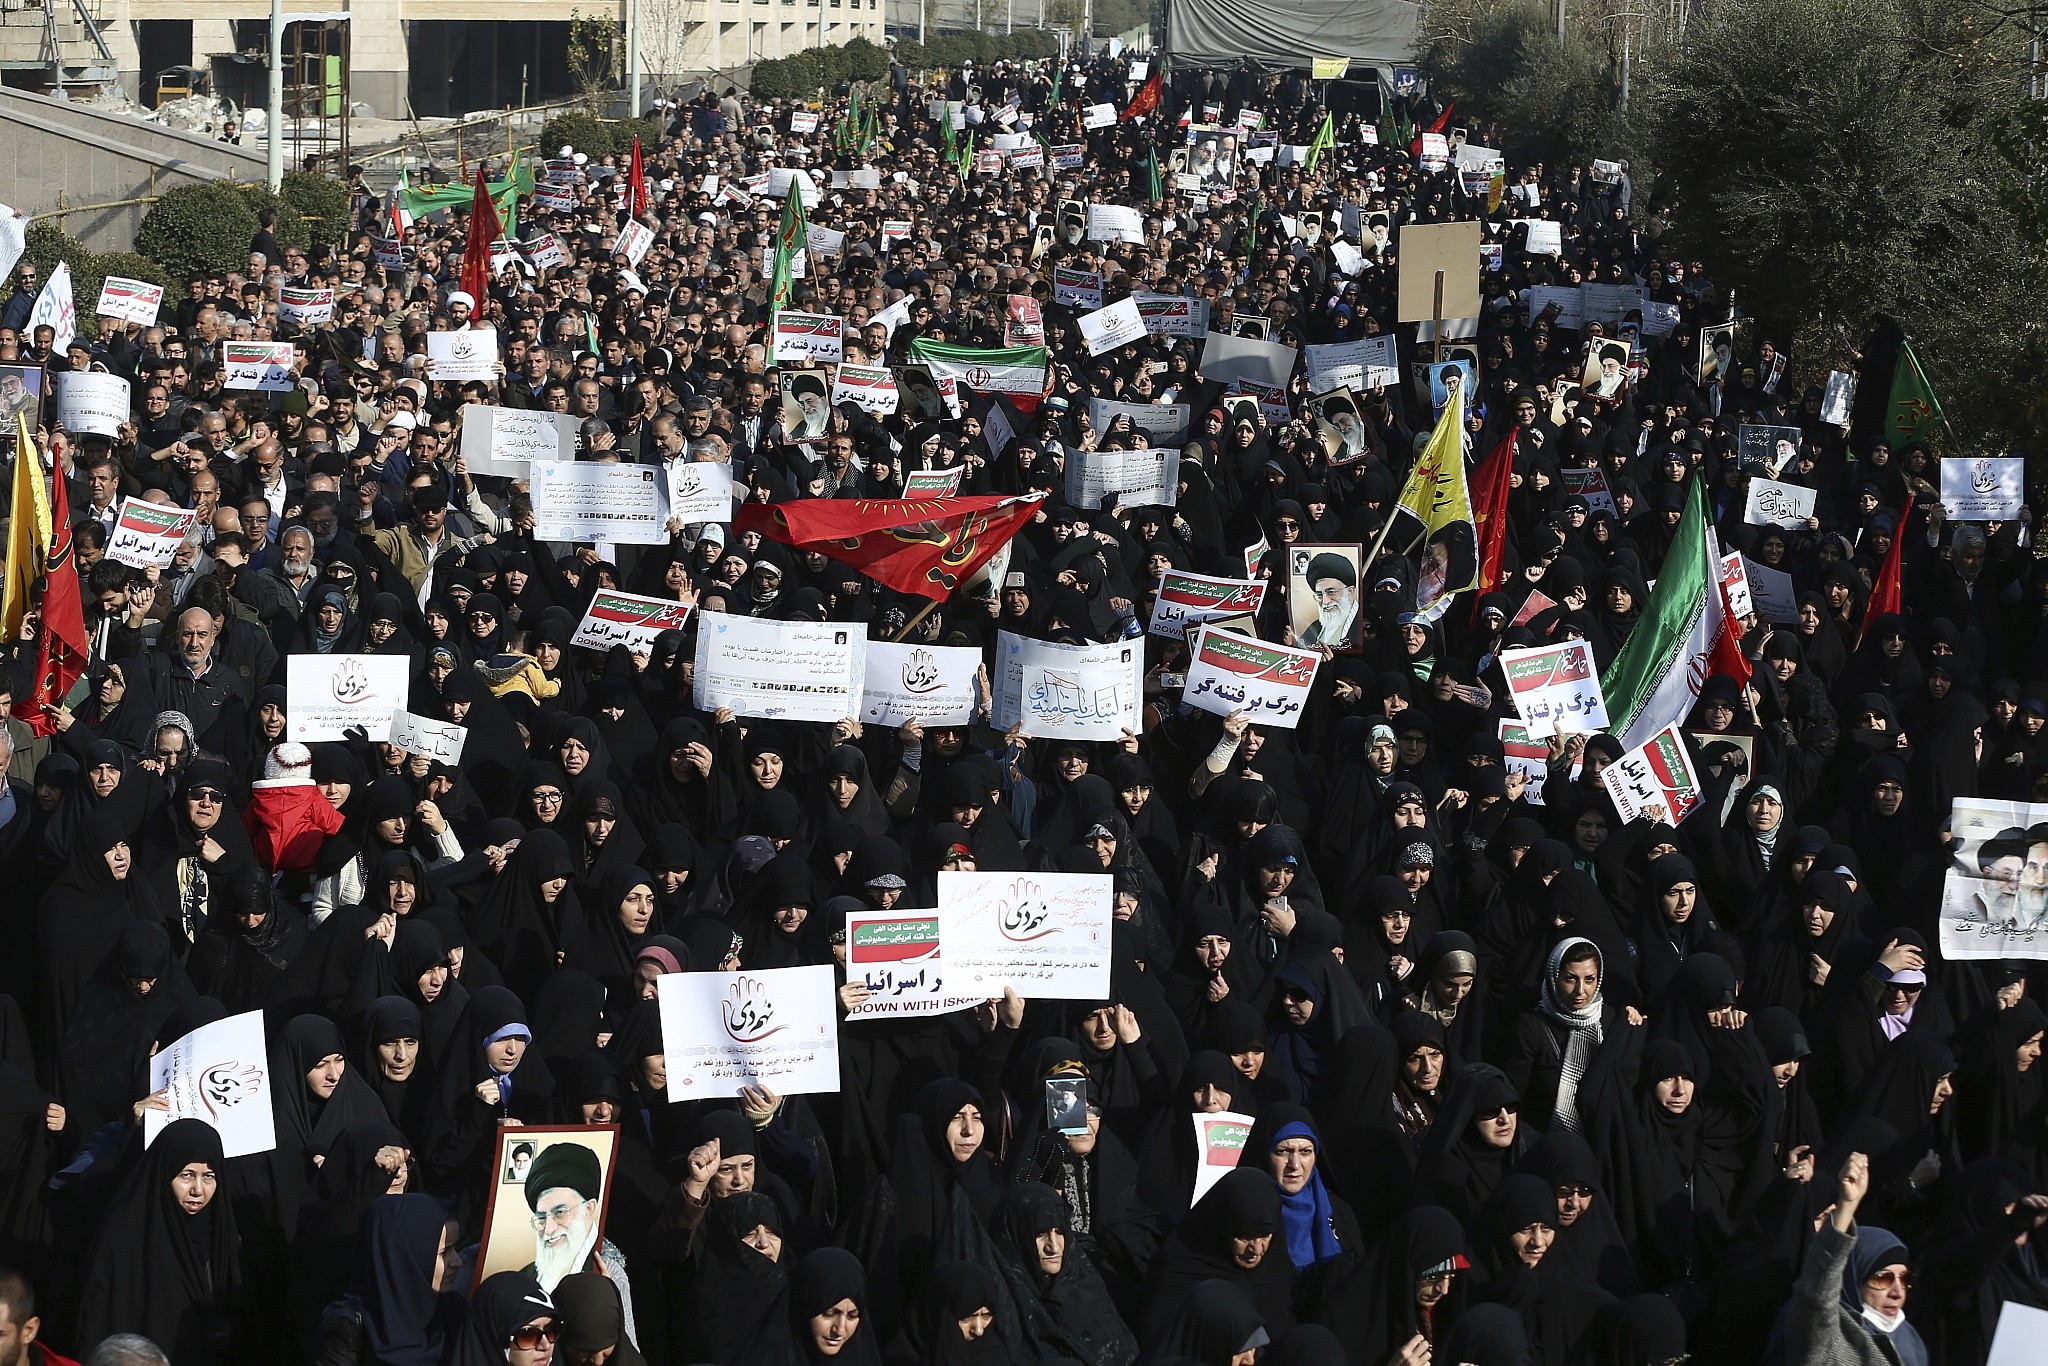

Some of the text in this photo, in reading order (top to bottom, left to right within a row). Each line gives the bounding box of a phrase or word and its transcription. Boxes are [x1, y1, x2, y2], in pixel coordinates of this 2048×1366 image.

[543, 251, 560, 261] مرگ
[102, 297, 129, 308] اسرائیل
[1085, 293, 1100, 304] مرگ
[139, 306, 155, 317] مرگ
[314, 309, 330, 318] مرگ
[1171, 318, 1189, 327] مرگ
[808, 344, 818, 354] بر
[819, 343, 840, 357] مرگ
[259, 374, 268, 384] بر
[865, 397, 876, 406] بر
[877, 396, 896, 408] مرگ
[1592, 496, 1612, 509] مرگ
[115, 534, 156, 553] اسرائیل
[109, 551, 136, 563] DOWN
[154, 547, 164, 557] بر
[582, 622, 643, 646] بر اسرائیل
[812, 634, 823, 642] علی
[576, 637, 607, 649] DOWN
[1230, 643, 1241, 651] قدرت
[907, 665, 925, 685] دی
[337, 674, 356, 695] دی
[1073, 683, 1120, 724] لبیک
[1243, 697, 1262, 711] بر
[1265, 695, 1299, 715] مرگ
[1567, 692, 1597, 715] مرگ
[1553, 701, 1565, 722] بر
[407, 714, 415, 731] یا
[422, 726, 461, 743] لبیک
[1620, 760, 1655, 800] اسرائیل
[1606, 769, 1636, 819] DOWN WITH
[1004, 901, 1030, 930] دی
[873, 925, 886, 934] الهی
[887, 924, 902, 932] قدرت
[917, 923, 930, 932] تجلی
[1053, 961, 1070, 969] سراسر
[1089, 961, 1099, 970] نهم
[1036, 970, 1044, 979] کار
[1045, 970, 1054, 979] این
[852, 1000, 939, 1014] DOWN WITH
[731, 1000, 755, 1031] دی
[711, 1069, 721, 1078] کرد
[1224, 1128, 1235, 1136] الهی
